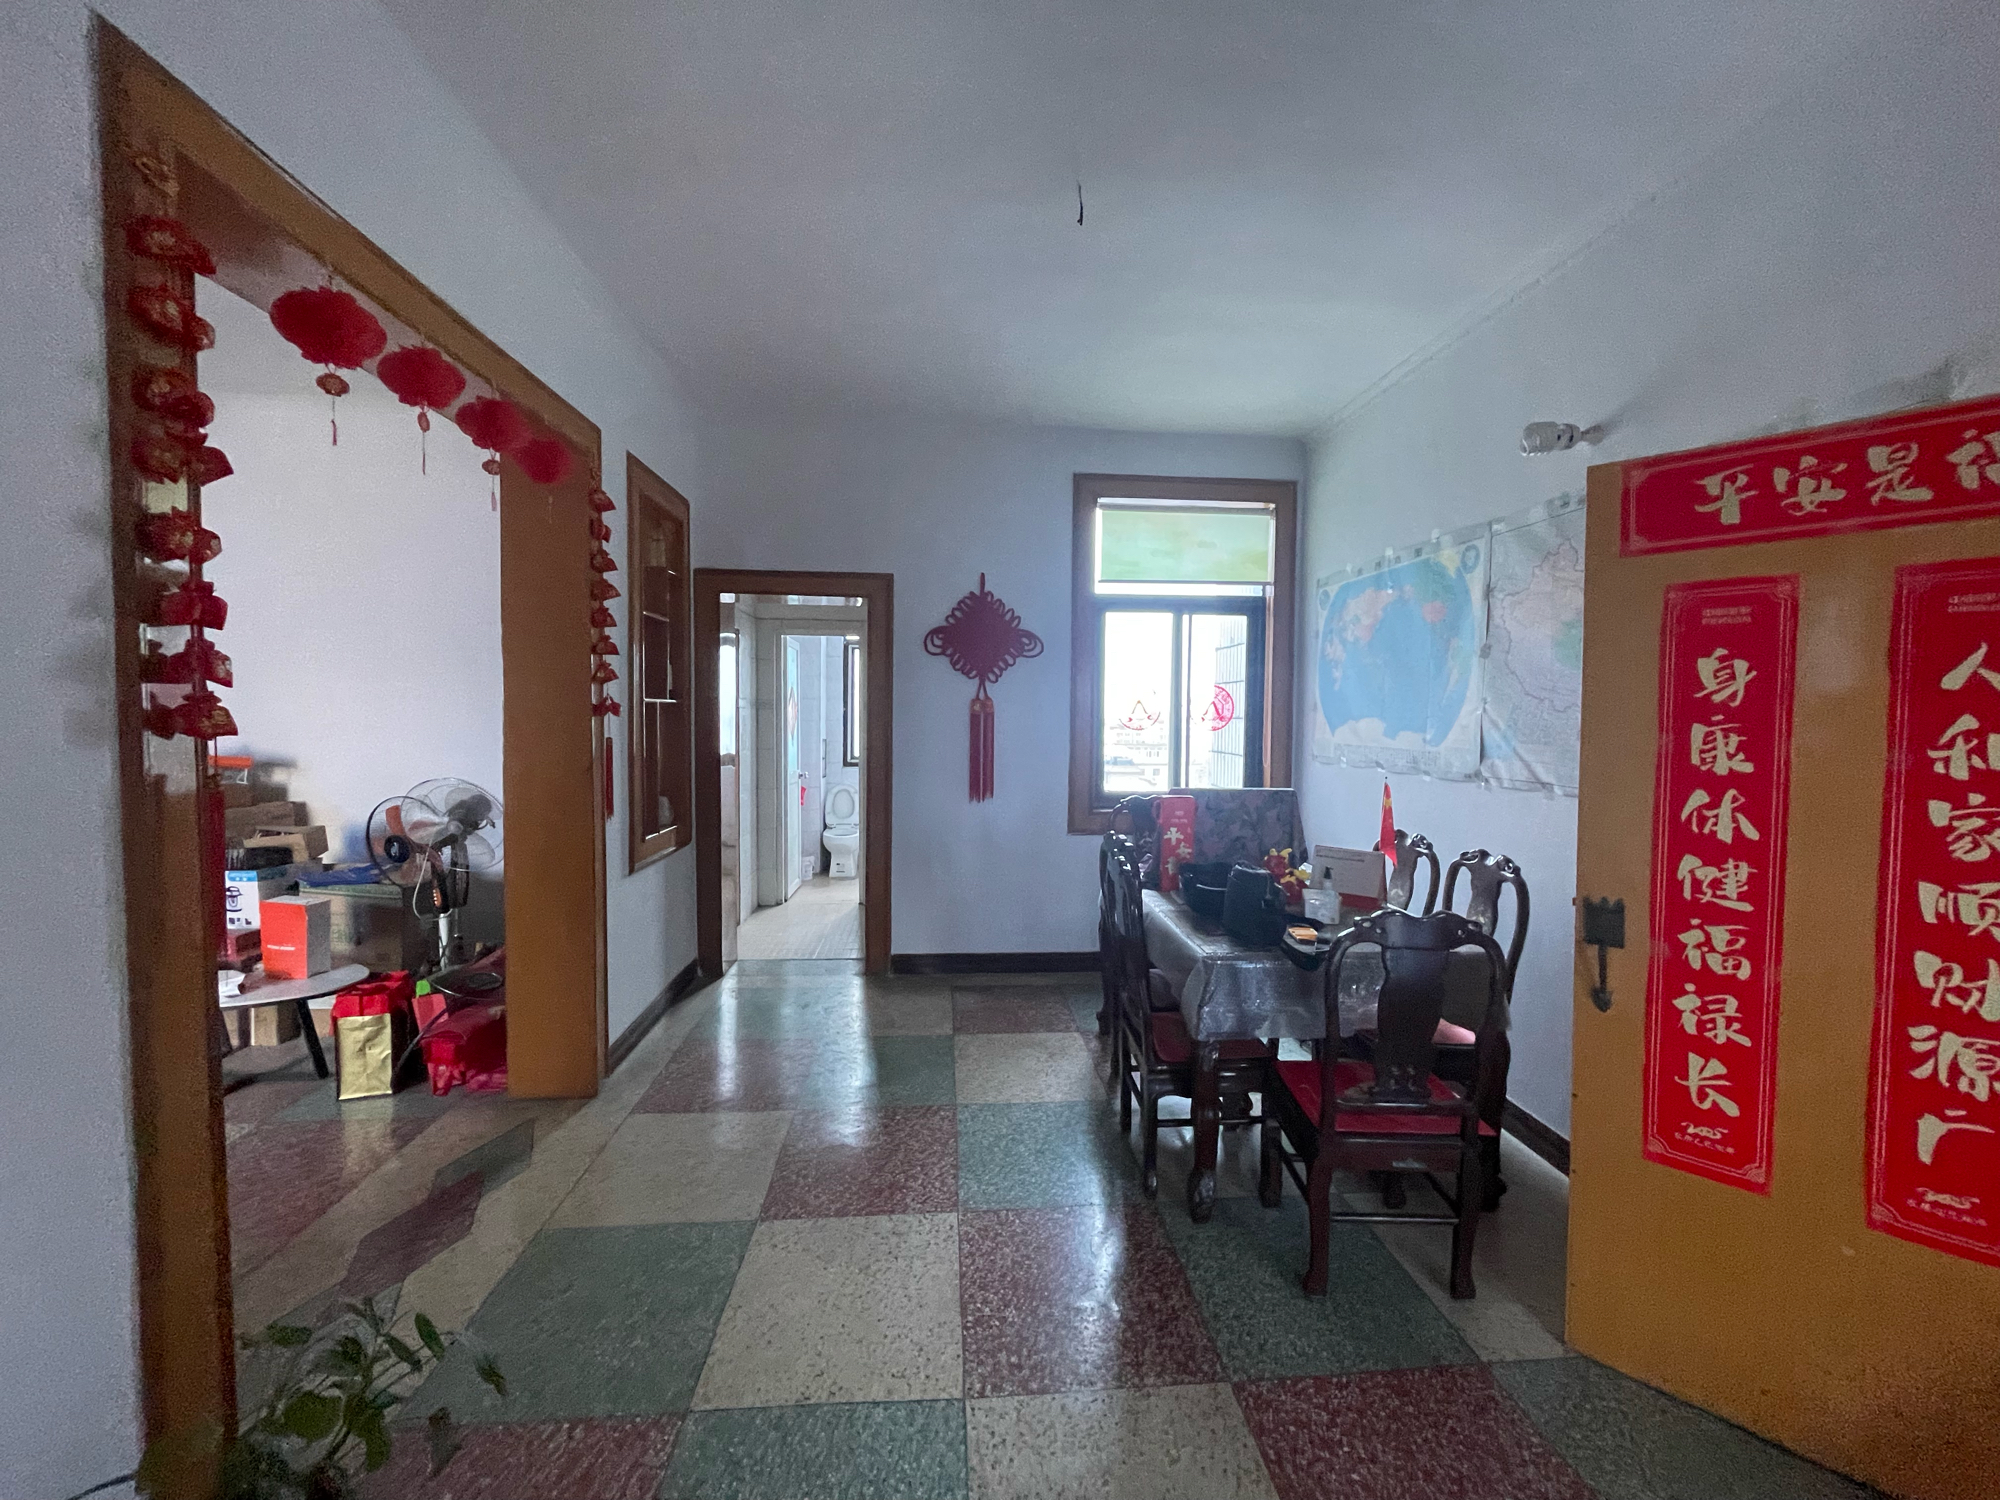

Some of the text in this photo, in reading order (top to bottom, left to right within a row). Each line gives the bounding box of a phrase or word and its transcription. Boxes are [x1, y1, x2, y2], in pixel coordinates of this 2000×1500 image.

[1672, 647, 1760, 1118] 身康体健福禄长
